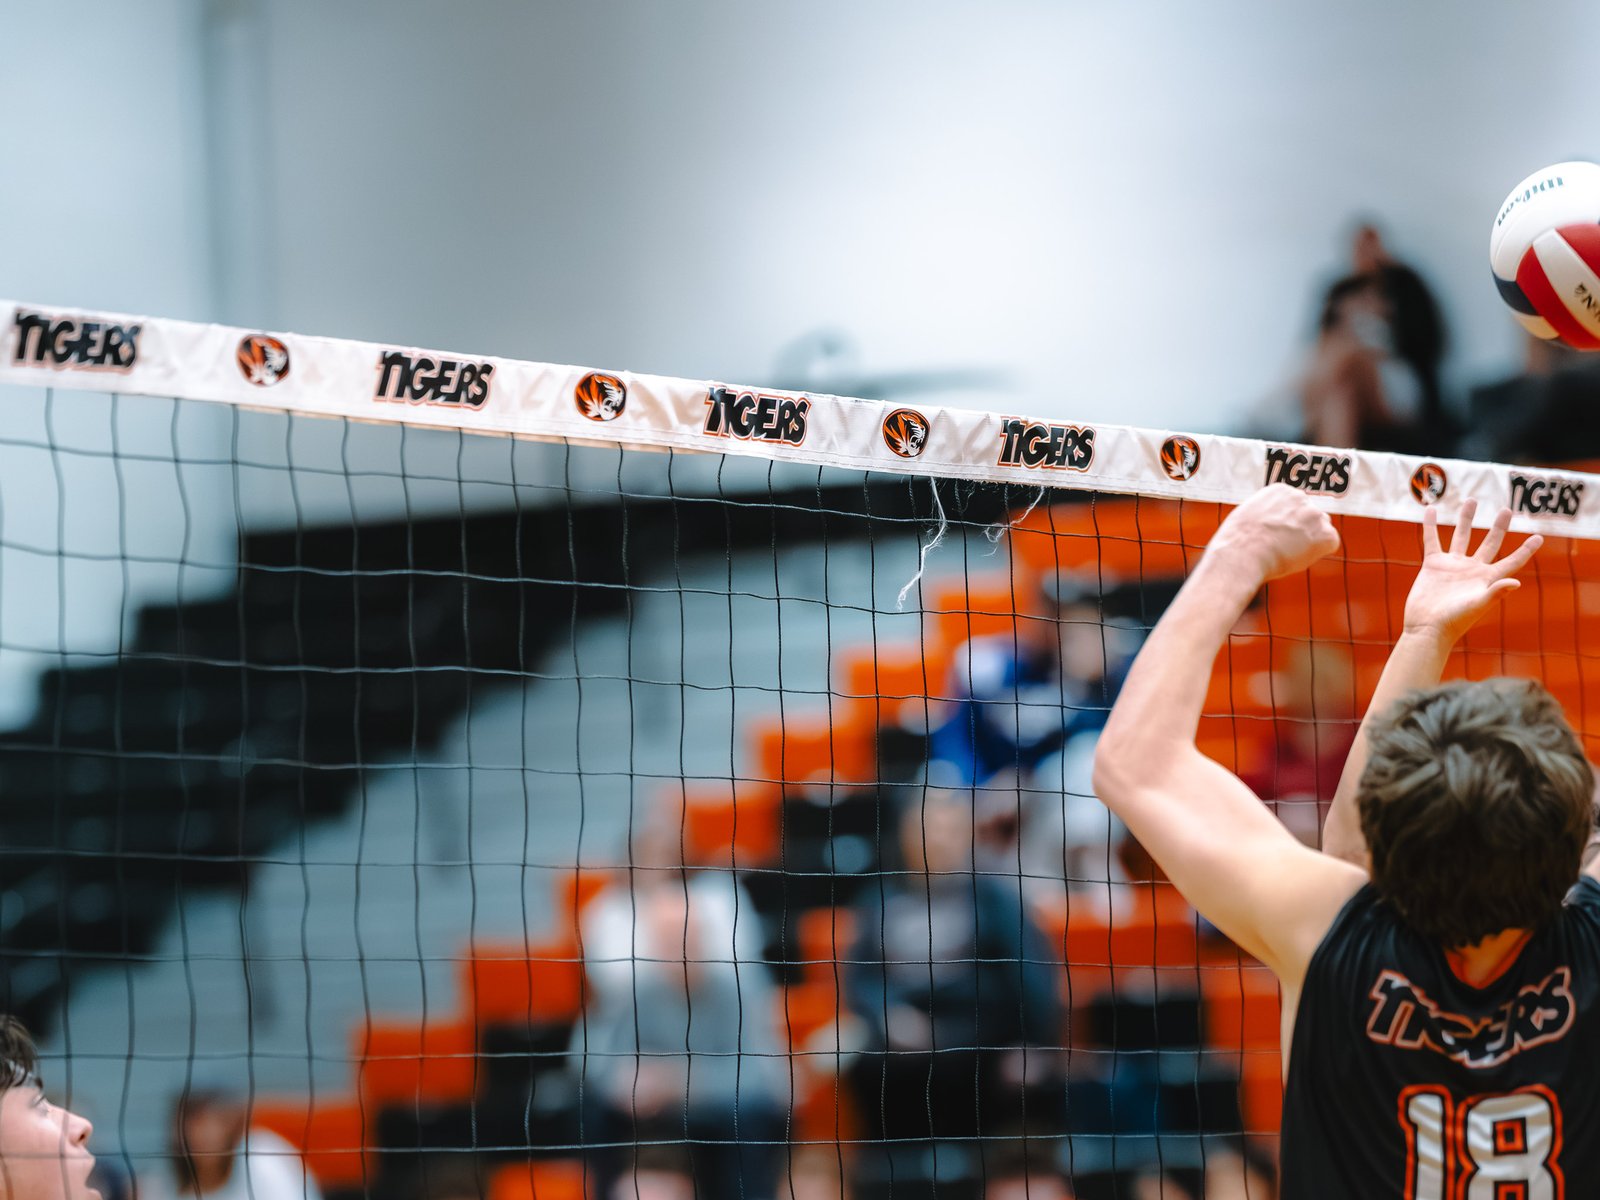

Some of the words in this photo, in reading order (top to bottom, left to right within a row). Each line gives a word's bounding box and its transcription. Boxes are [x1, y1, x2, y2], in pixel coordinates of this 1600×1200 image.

[14, 310, 142, 370] TIGERS
[376, 350, 494, 407] TIGERS
[703, 385, 811, 446] TIGERS
[998, 415, 1097, 472] TIGERS
[1264, 446, 1351, 497] TIGERS
[1509, 471, 1585, 518] TIGERS
